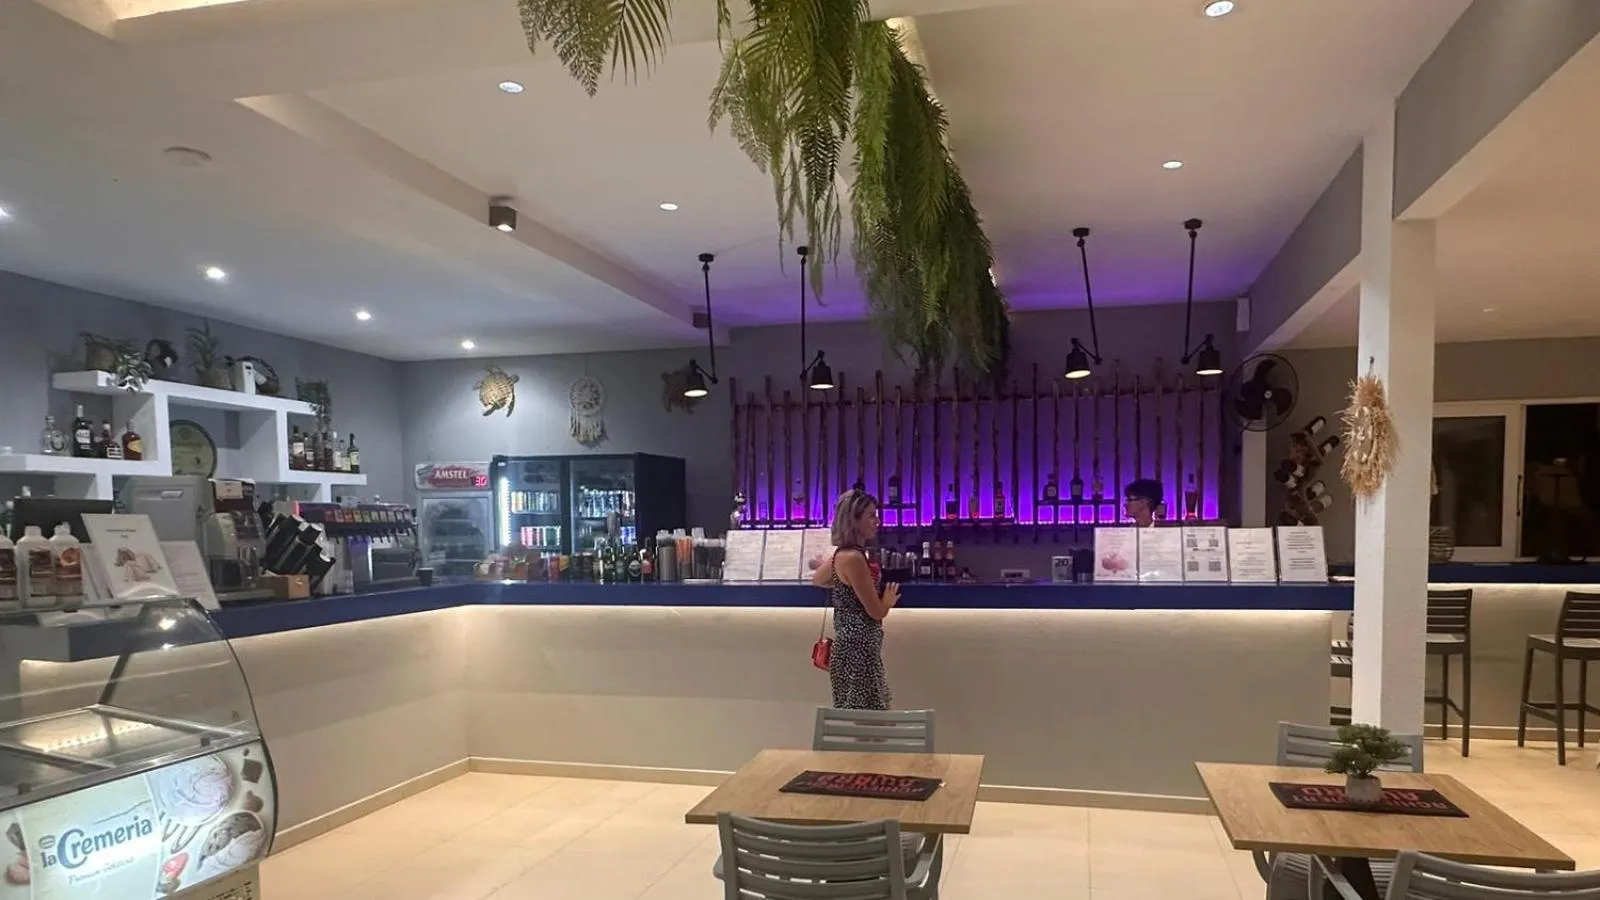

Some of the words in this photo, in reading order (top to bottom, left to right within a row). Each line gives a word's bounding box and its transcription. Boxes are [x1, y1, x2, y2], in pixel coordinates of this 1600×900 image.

[434, 470, 467, 479] AMSTEL
[40, 852, 57, 868] la
[57, 815, 153, 869] Cremeria
